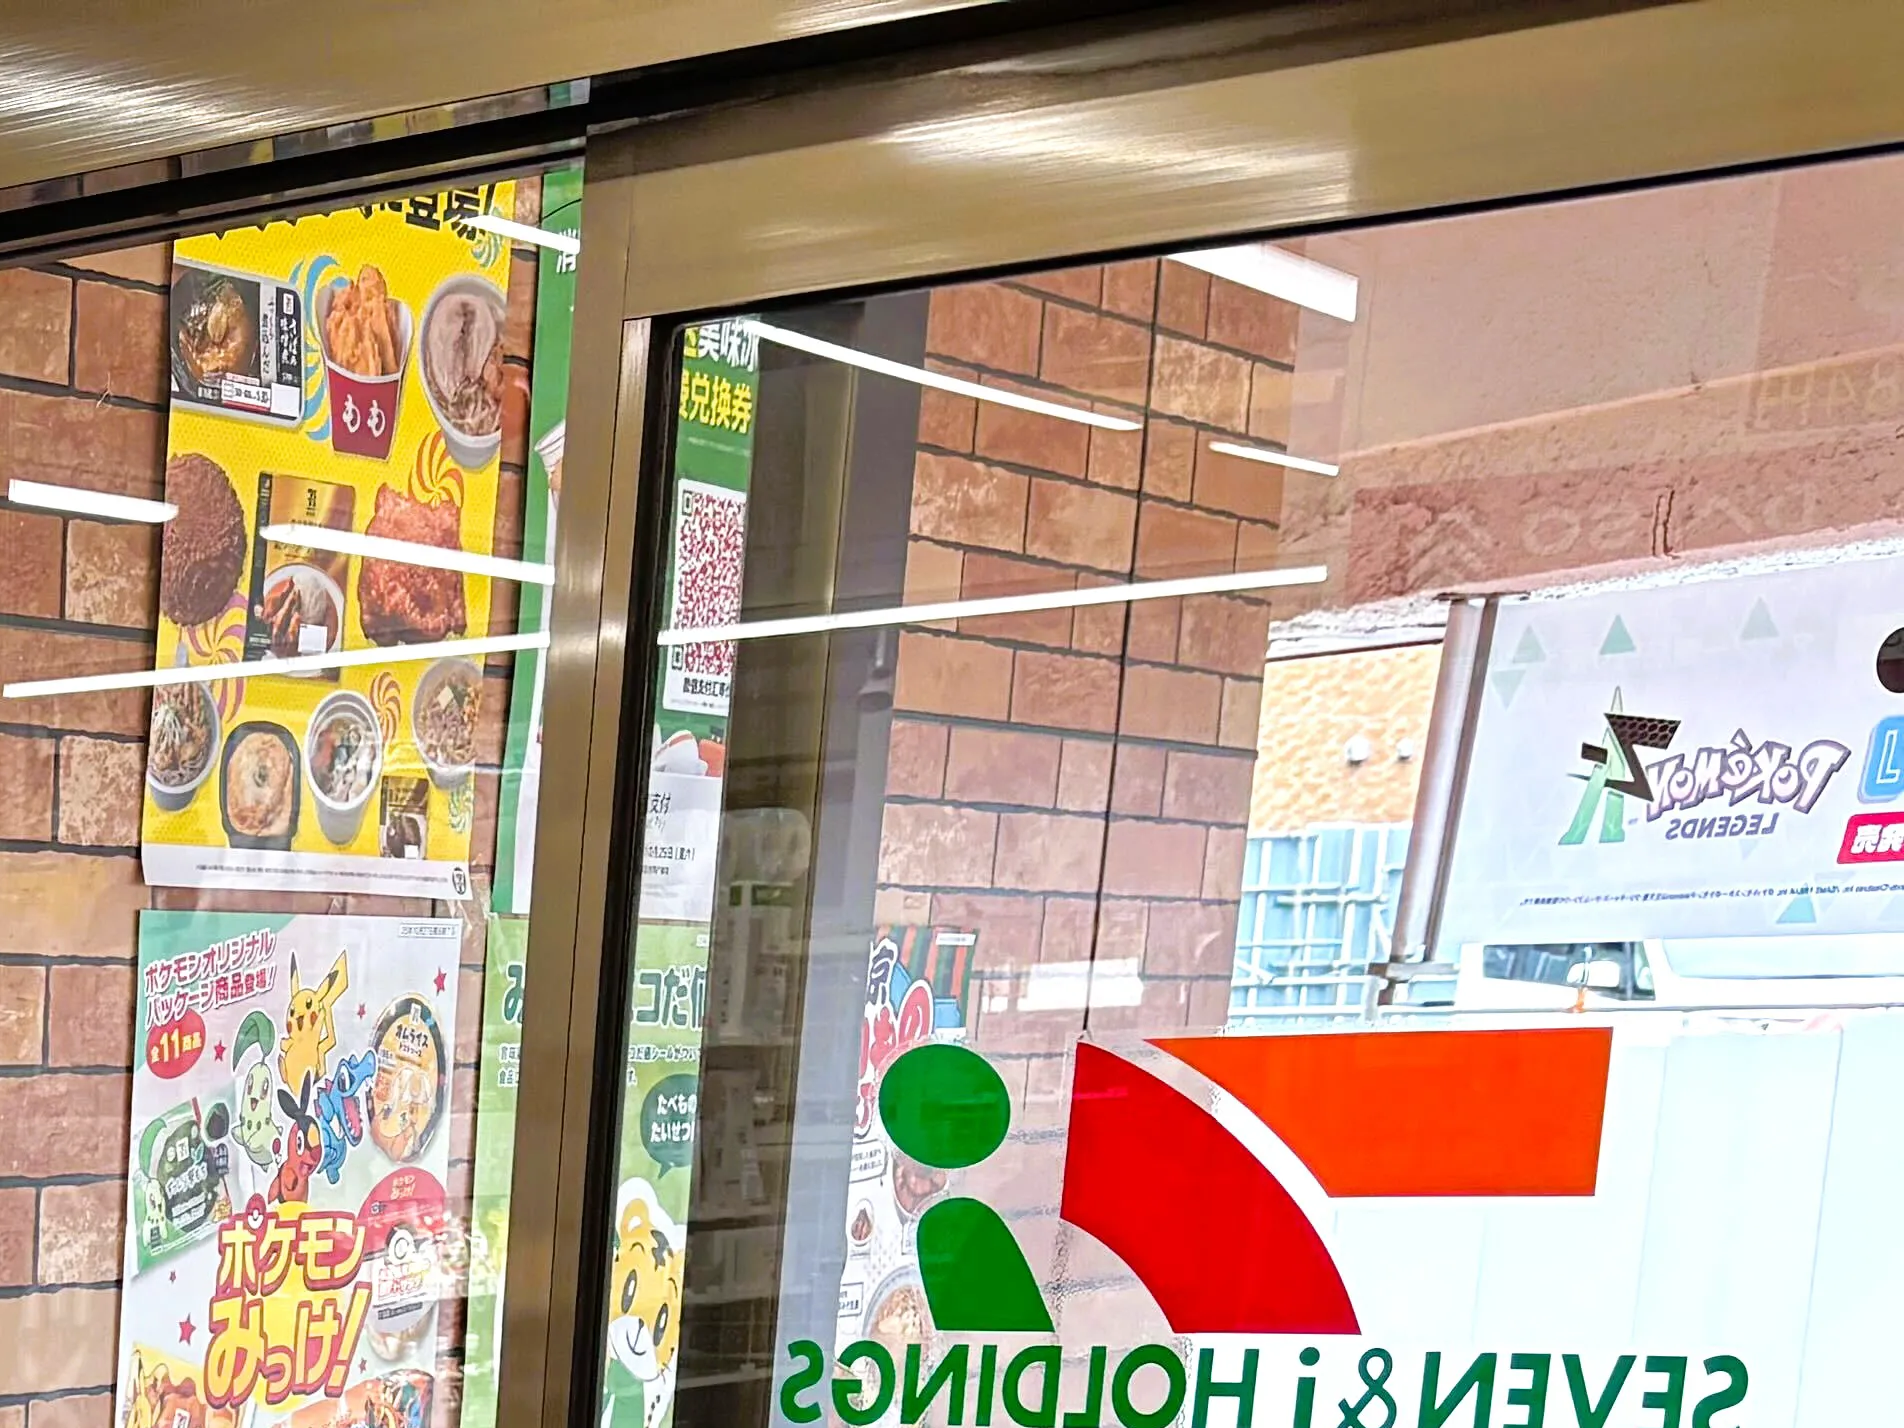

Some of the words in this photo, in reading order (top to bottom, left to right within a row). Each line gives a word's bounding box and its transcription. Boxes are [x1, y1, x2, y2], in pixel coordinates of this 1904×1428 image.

[144, 928, 275, 994] ポケモンオリジナル
[218, 1214, 368, 1294] ポケモン
[204, 1282, 372, 1408] みっけ!
